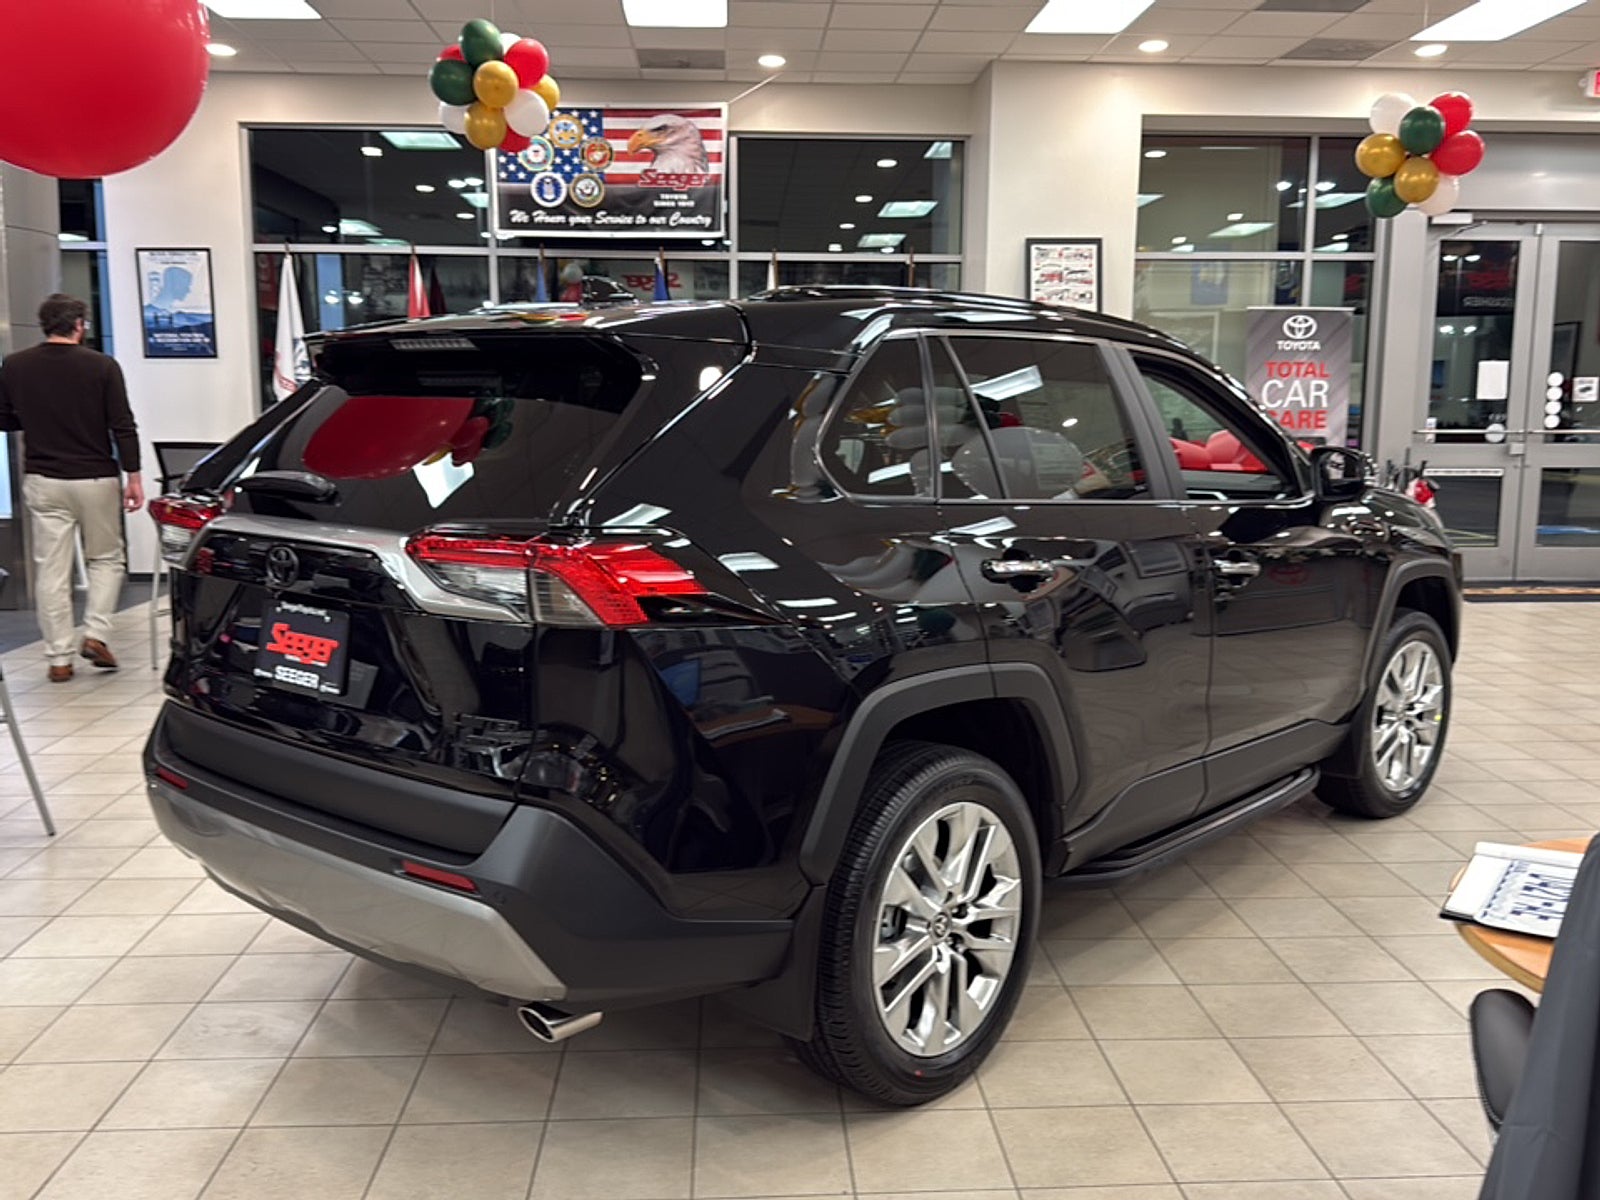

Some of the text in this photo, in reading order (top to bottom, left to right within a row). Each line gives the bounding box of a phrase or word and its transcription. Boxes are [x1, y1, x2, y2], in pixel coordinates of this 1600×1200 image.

[638, 169, 709, 191] Seeger
[532, 210, 566, 224] Honor
[568, 214, 592, 227] your
[595, 211, 634, 225] Service
[635, 214, 647, 225] to
[649, 215, 666, 225] our
[669, 211, 712, 227] Country
[1276, 340, 1321, 350] TOYOTA
[1265, 361, 1331, 378] TOTAL
[1261, 379, 1329, 408] CAR
[266, 622, 340, 664] Seeger
[275, 665, 319, 689] SEEGER
